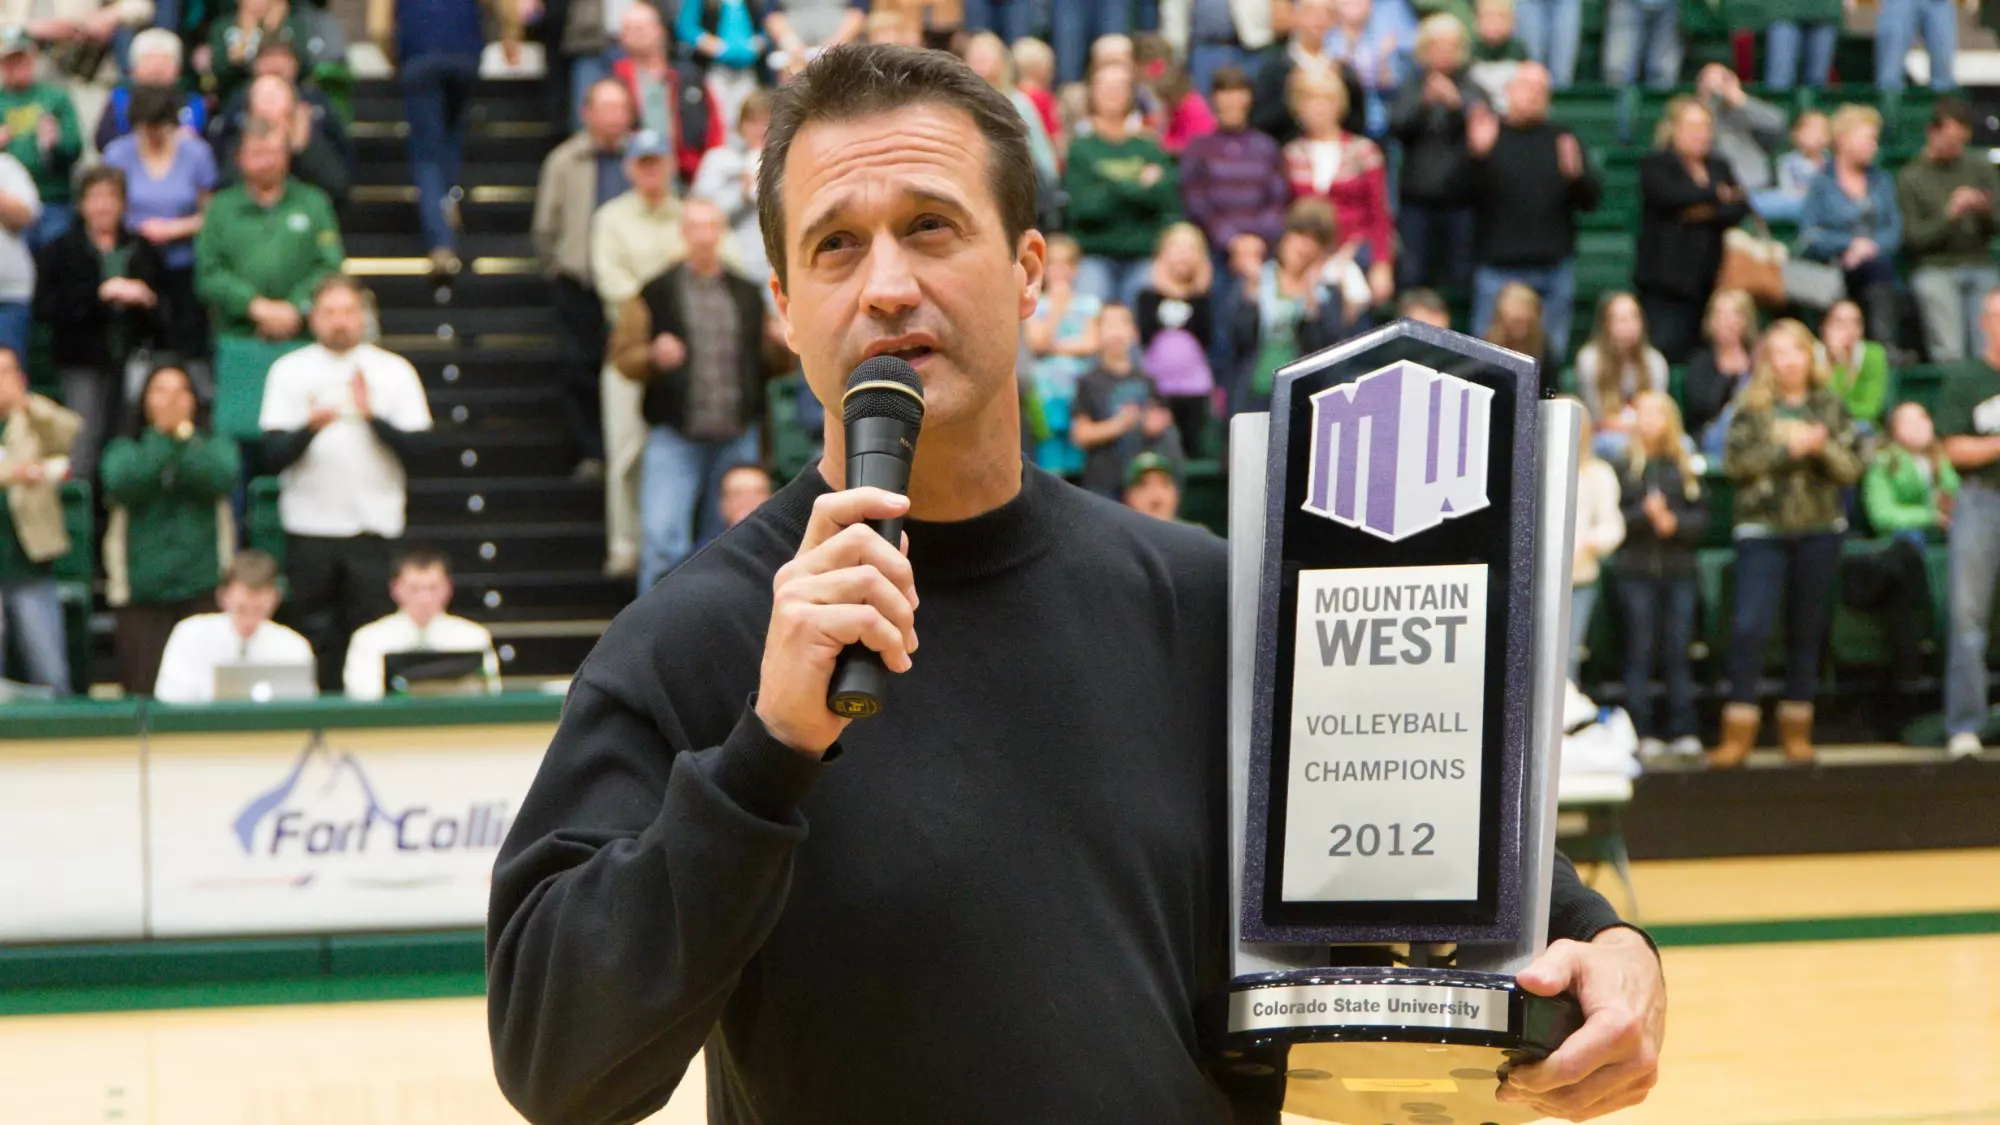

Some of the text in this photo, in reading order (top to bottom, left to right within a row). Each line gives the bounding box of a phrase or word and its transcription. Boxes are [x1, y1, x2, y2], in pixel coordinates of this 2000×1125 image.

[1315, 583, 1468, 614] MOUNTAIN
[1315, 615, 1468, 667] WEST
[1306, 712, 1468, 736] VOLLEYBALL
[1304, 758, 1465, 782] CHAMPIONS
[269, 804, 378, 855] Fort
[1328, 822, 1436, 857] 2012
[1253, 998, 1480, 1019] Colorado State University
